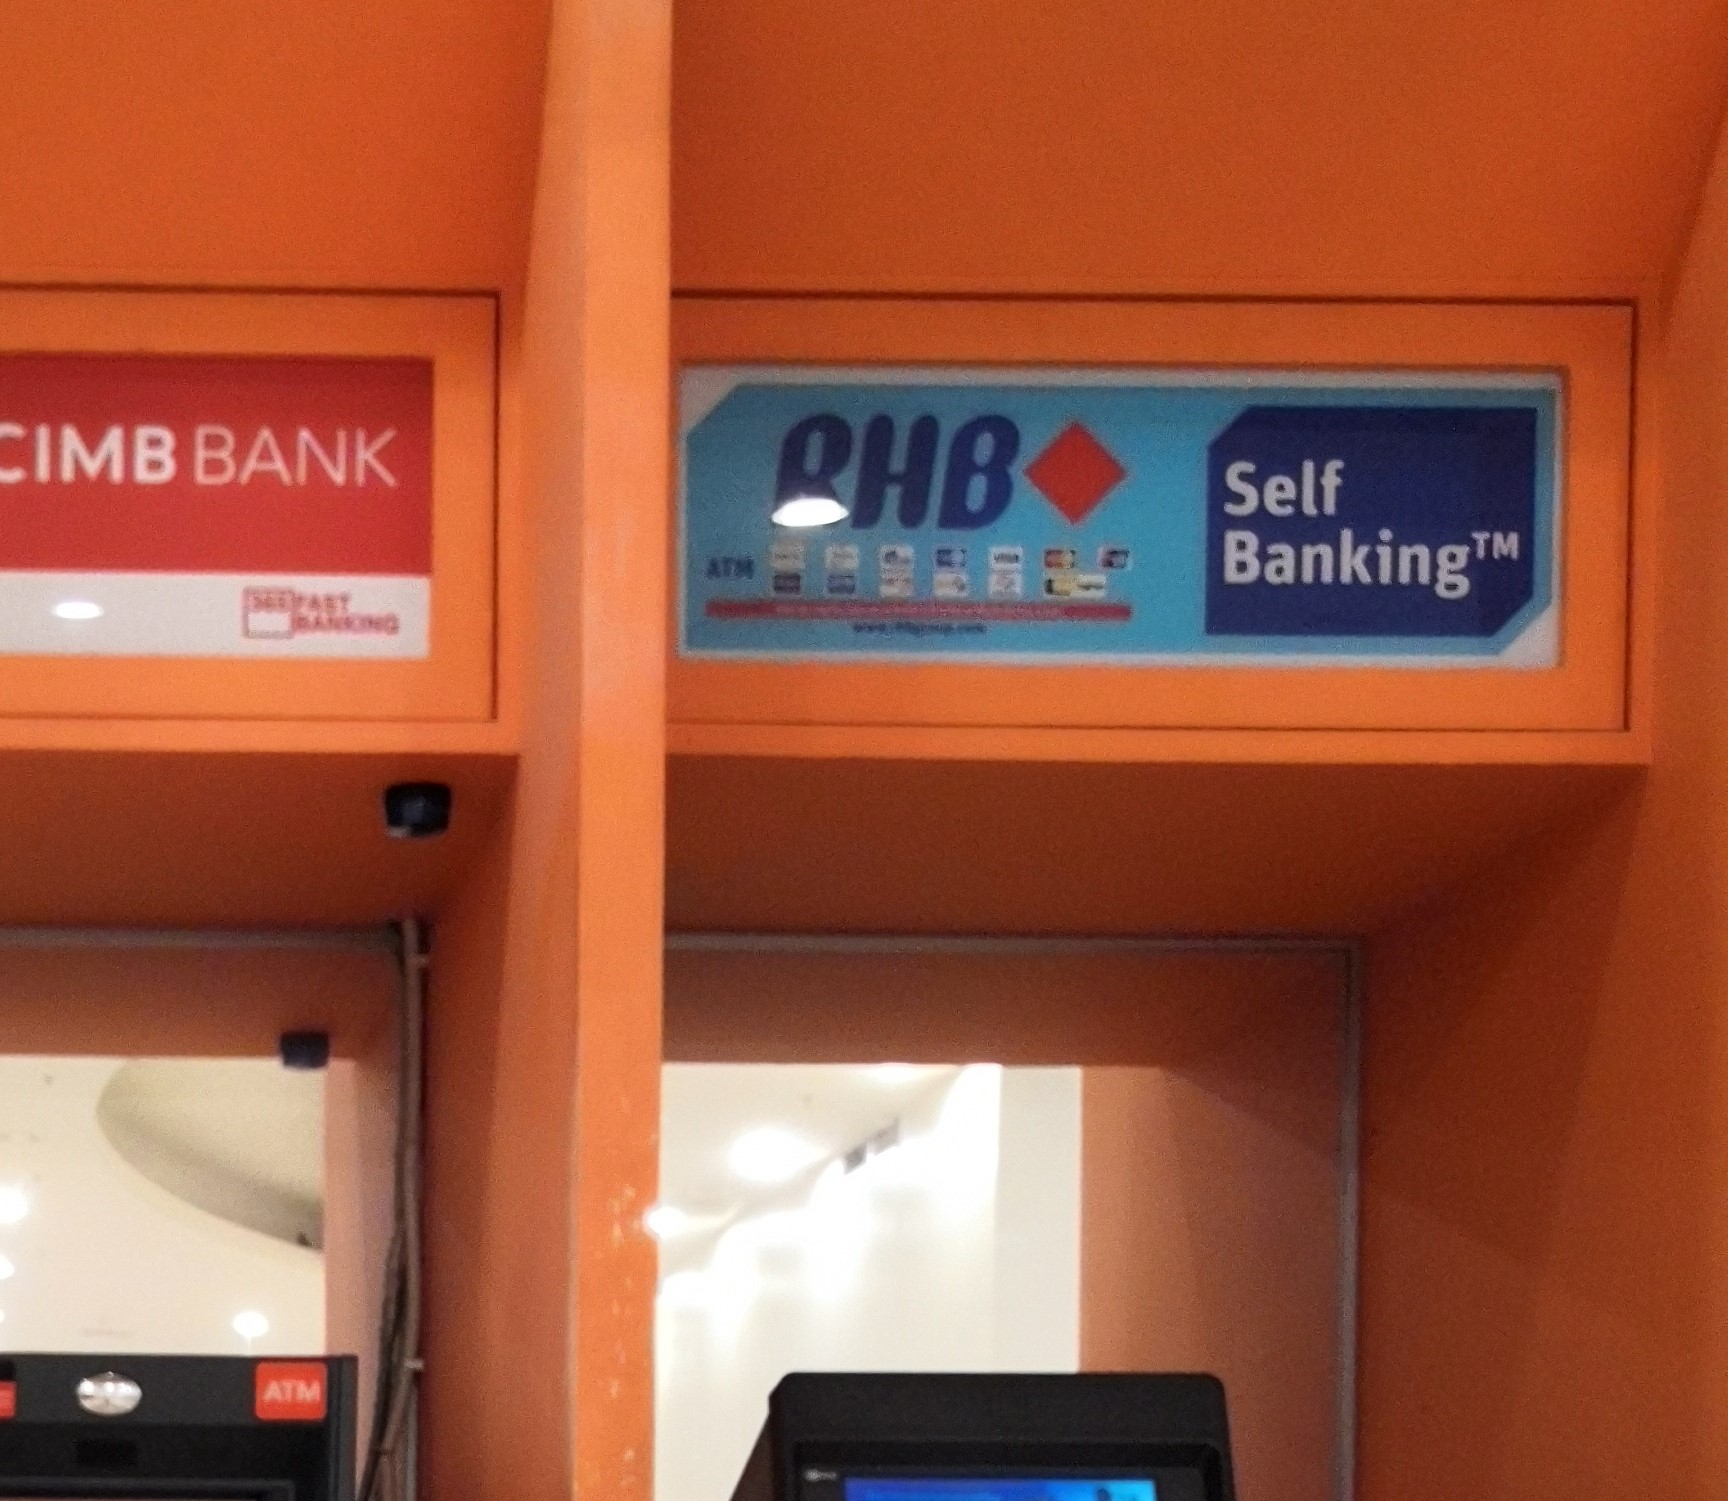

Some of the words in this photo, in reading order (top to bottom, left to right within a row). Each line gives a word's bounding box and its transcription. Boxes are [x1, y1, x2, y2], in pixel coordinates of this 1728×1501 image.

[193, 424, 399, 488] BANK
[772, 413, 1020, 530] RHB
[1223, 459, 1345, 517] Self
[262, 1380, 322, 1404] ATM
